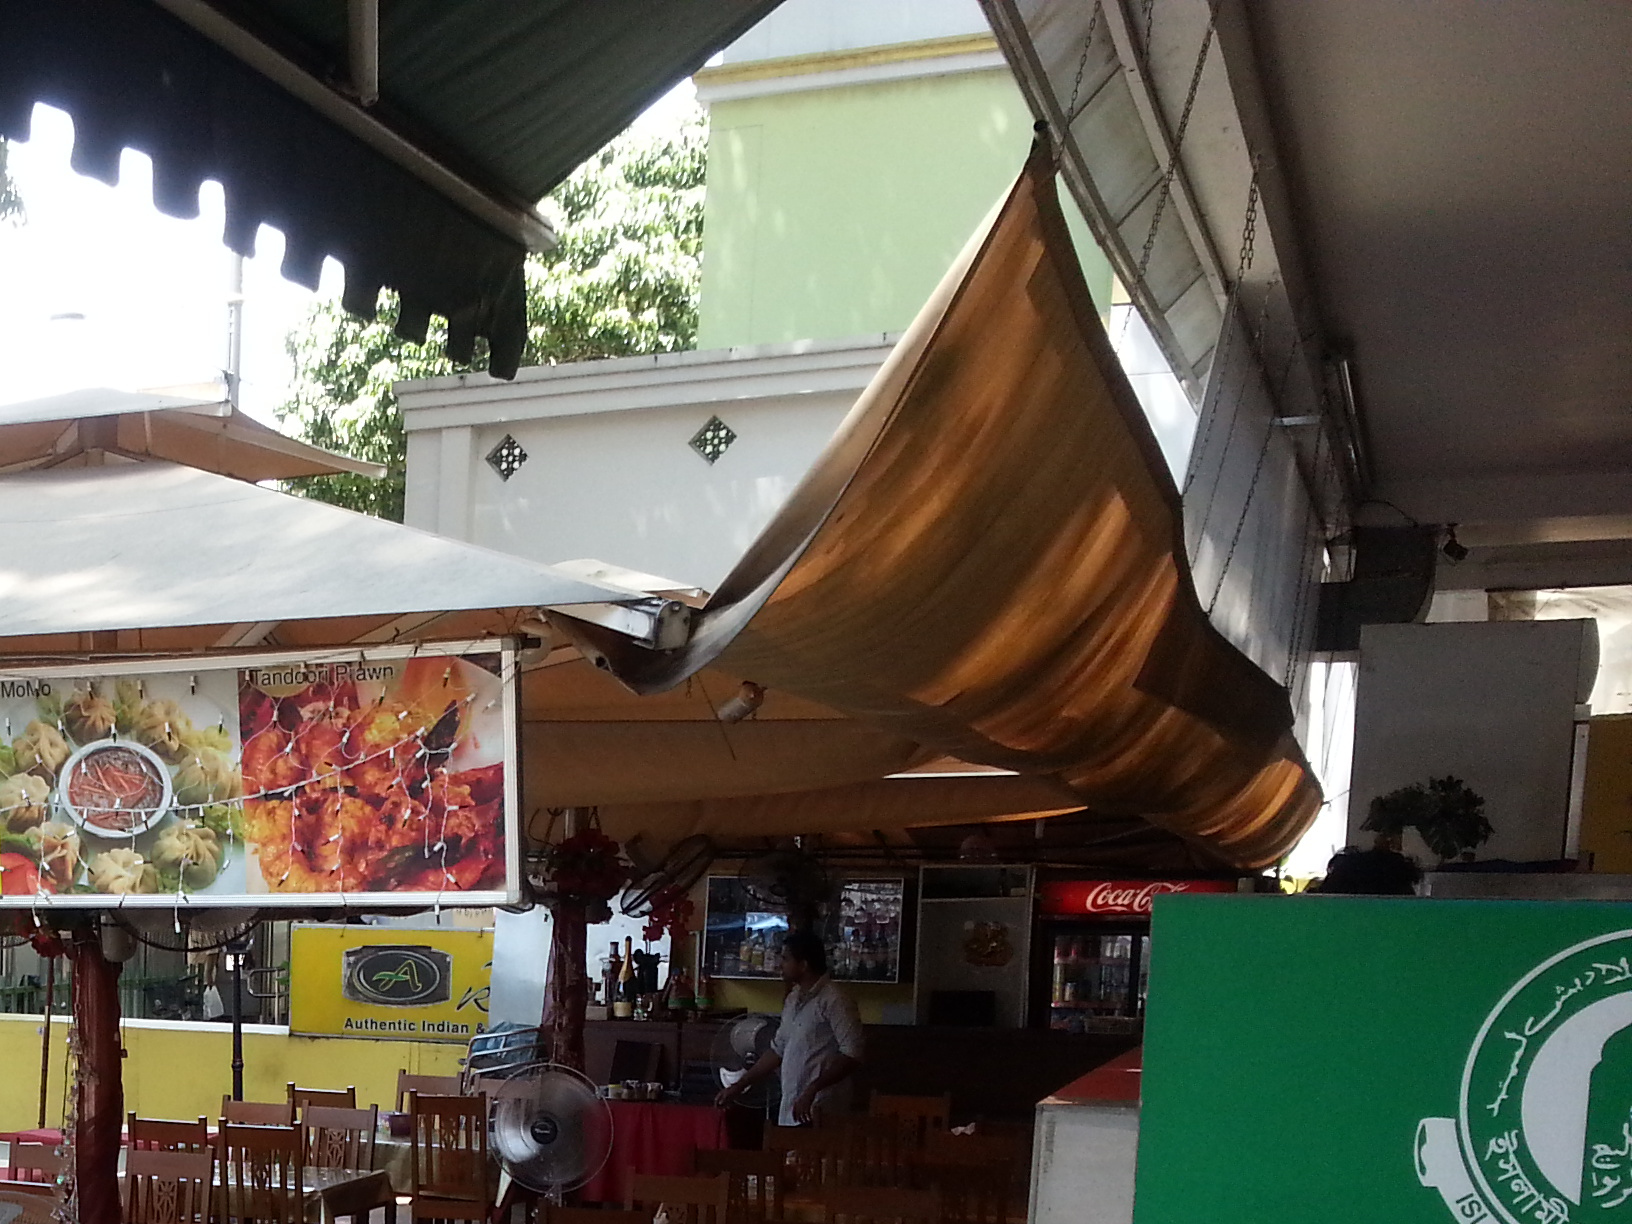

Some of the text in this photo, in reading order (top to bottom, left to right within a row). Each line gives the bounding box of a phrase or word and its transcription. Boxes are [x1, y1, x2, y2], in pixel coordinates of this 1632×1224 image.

[252, 664, 394, 687] Tandoori Prawn
[0, 681, 51, 698] MoMo
[344, 1017, 485, 1034] Authentic Indian &
